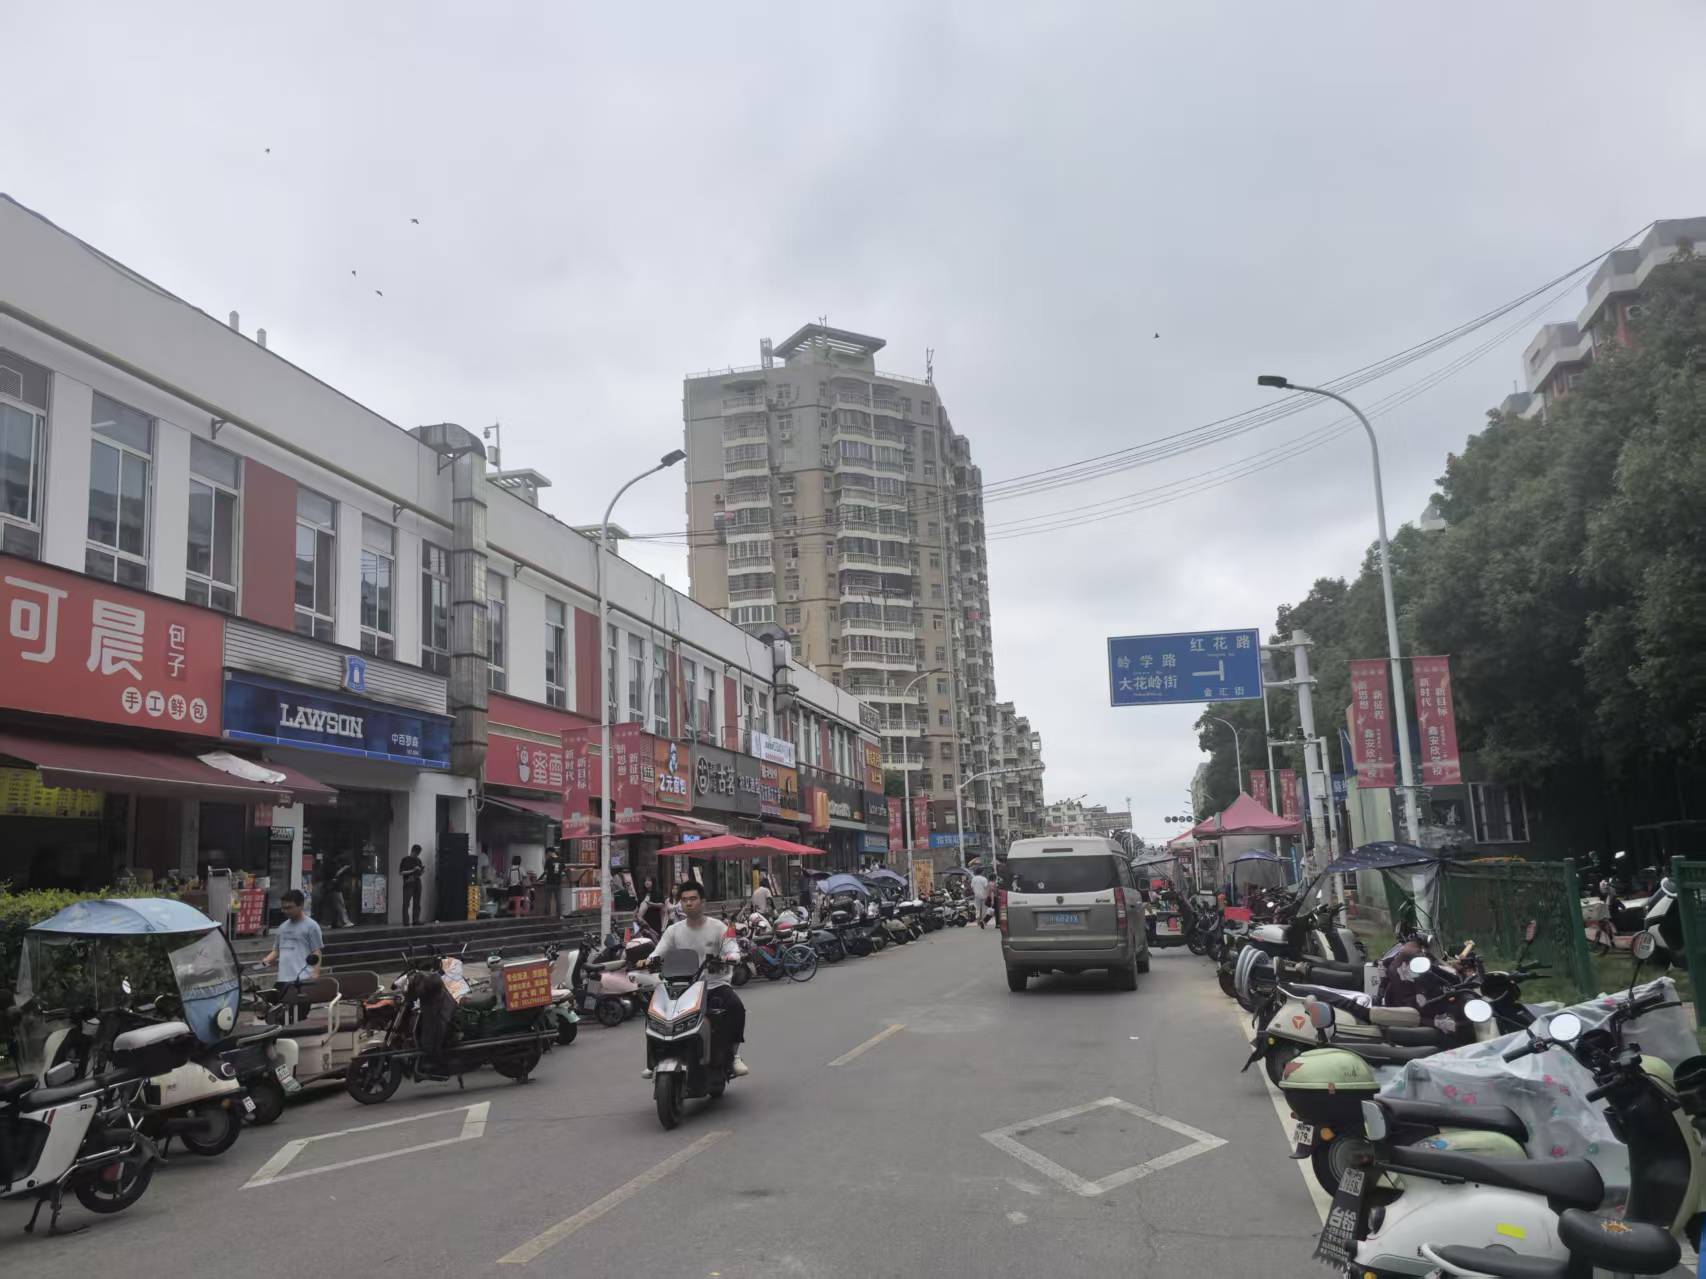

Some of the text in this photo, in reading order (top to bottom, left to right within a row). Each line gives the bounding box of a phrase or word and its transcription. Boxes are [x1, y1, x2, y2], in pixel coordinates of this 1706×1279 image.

[4, 575, 146, 681] 可晨
[1189, 634, 1251, 652] 红花路
[167, 623, 185, 678] 包子
[1119, 674, 1179, 692] 大花岭街
[1419, 677, 1432, 707] 新时代
[124, 690, 206, 720] 手工鲜包
[280, 703, 364, 739] LAWSON
[532, 749, 562, 787] 蜜雪
[565, 748, 575, 782] 新时代
[577, 756, 587, 789] 新目标
[629, 752, 639, 785] 新征程
